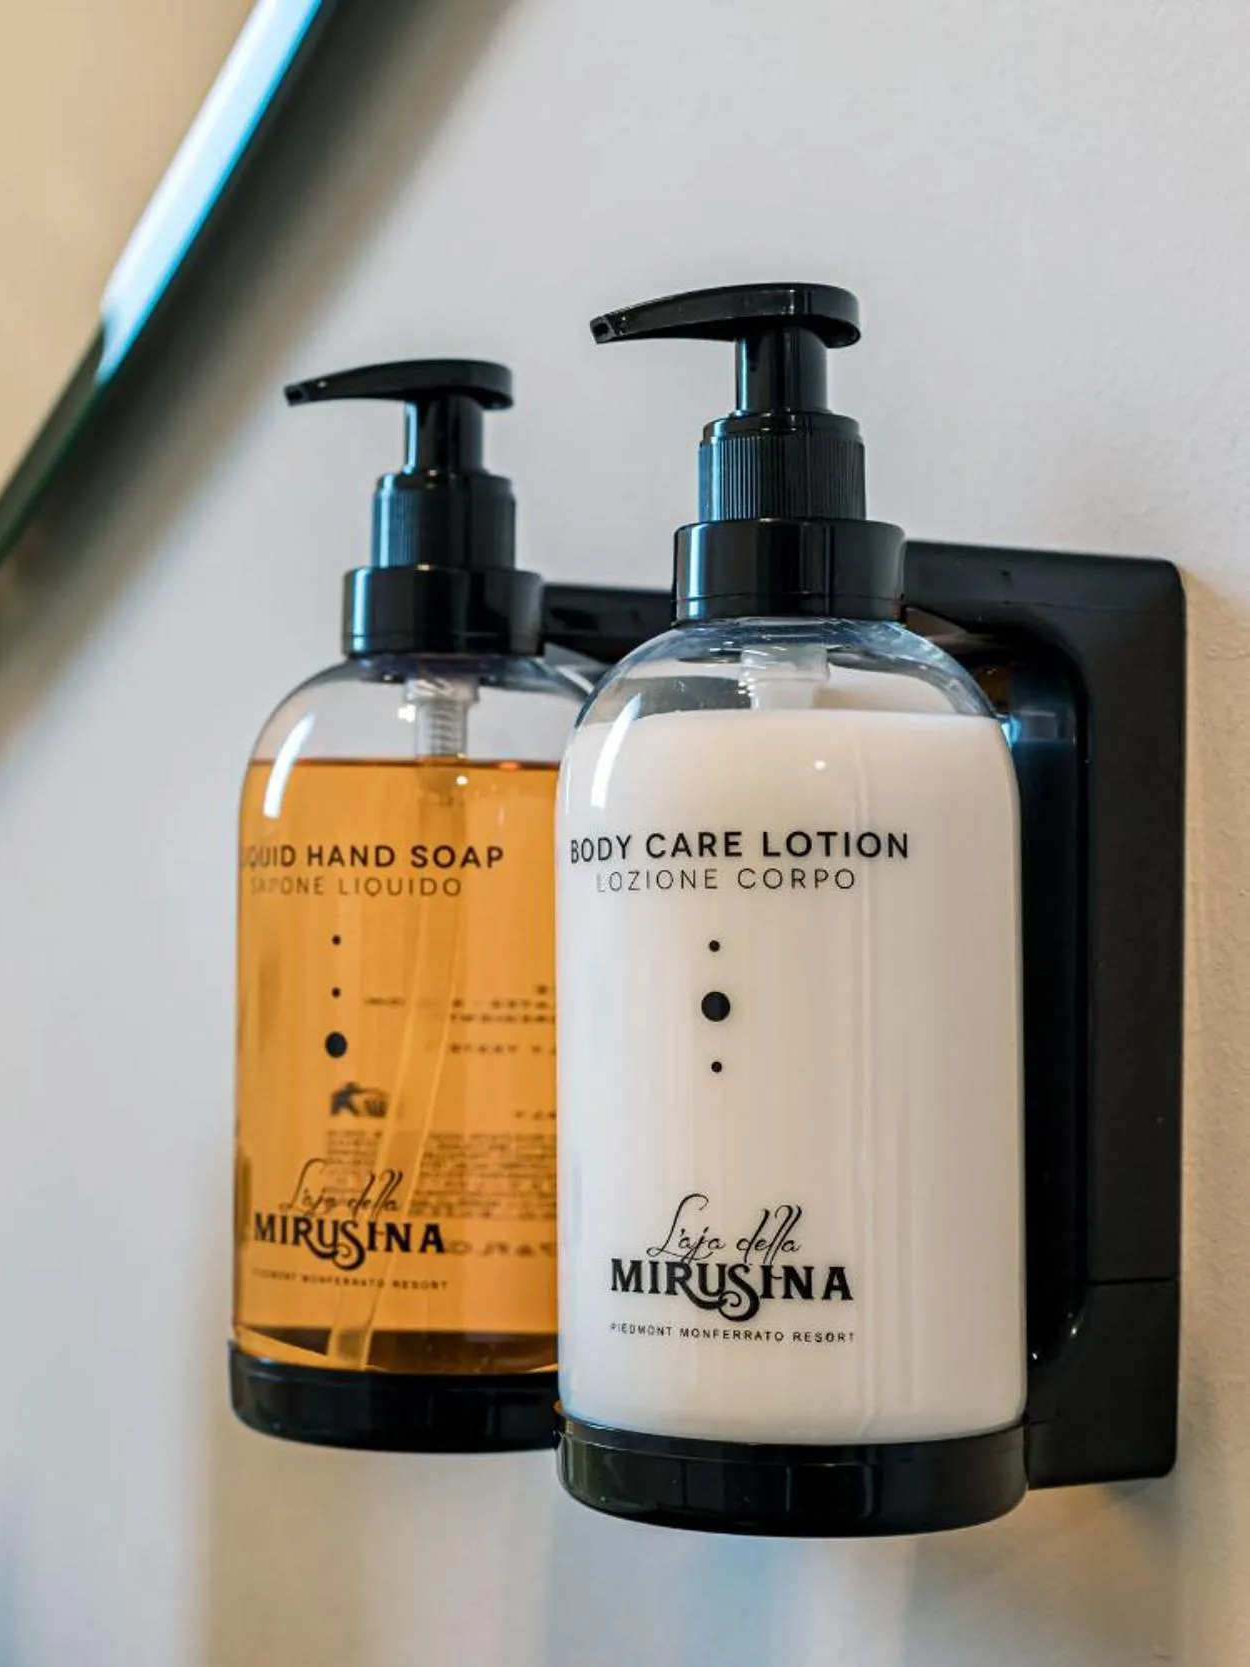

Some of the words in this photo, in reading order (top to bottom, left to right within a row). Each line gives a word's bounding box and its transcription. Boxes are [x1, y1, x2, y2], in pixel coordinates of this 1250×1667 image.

[307, 845, 396, 868] HAND
[410, 844, 504, 868] SOAP
[570, 834, 632, 864] BODY
[645, 831, 743, 859] CARE
[763, 831, 908, 859] LOTION
[249, 876, 325, 896] SAPONE
[338, 877, 462, 897] LIQUIDO
[596, 868, 719, 893] LOZIONE
[737, 867, 856, 891] CORPO
[347, 1168, 404, 1220] della
[253, 1212, 446, 1271] MIRUSINA
[646, 1192, 726, 1264] L'aja
[736, 1203, 803, 1265] della
[610, 1257, 855, 1323] MIRUSINA
[608, 1322, 673, 1338] PIEDMONT
[679, 1327, 784, 1342] MONFERRATO
[792, 1331, 855, 1344] RESORT
